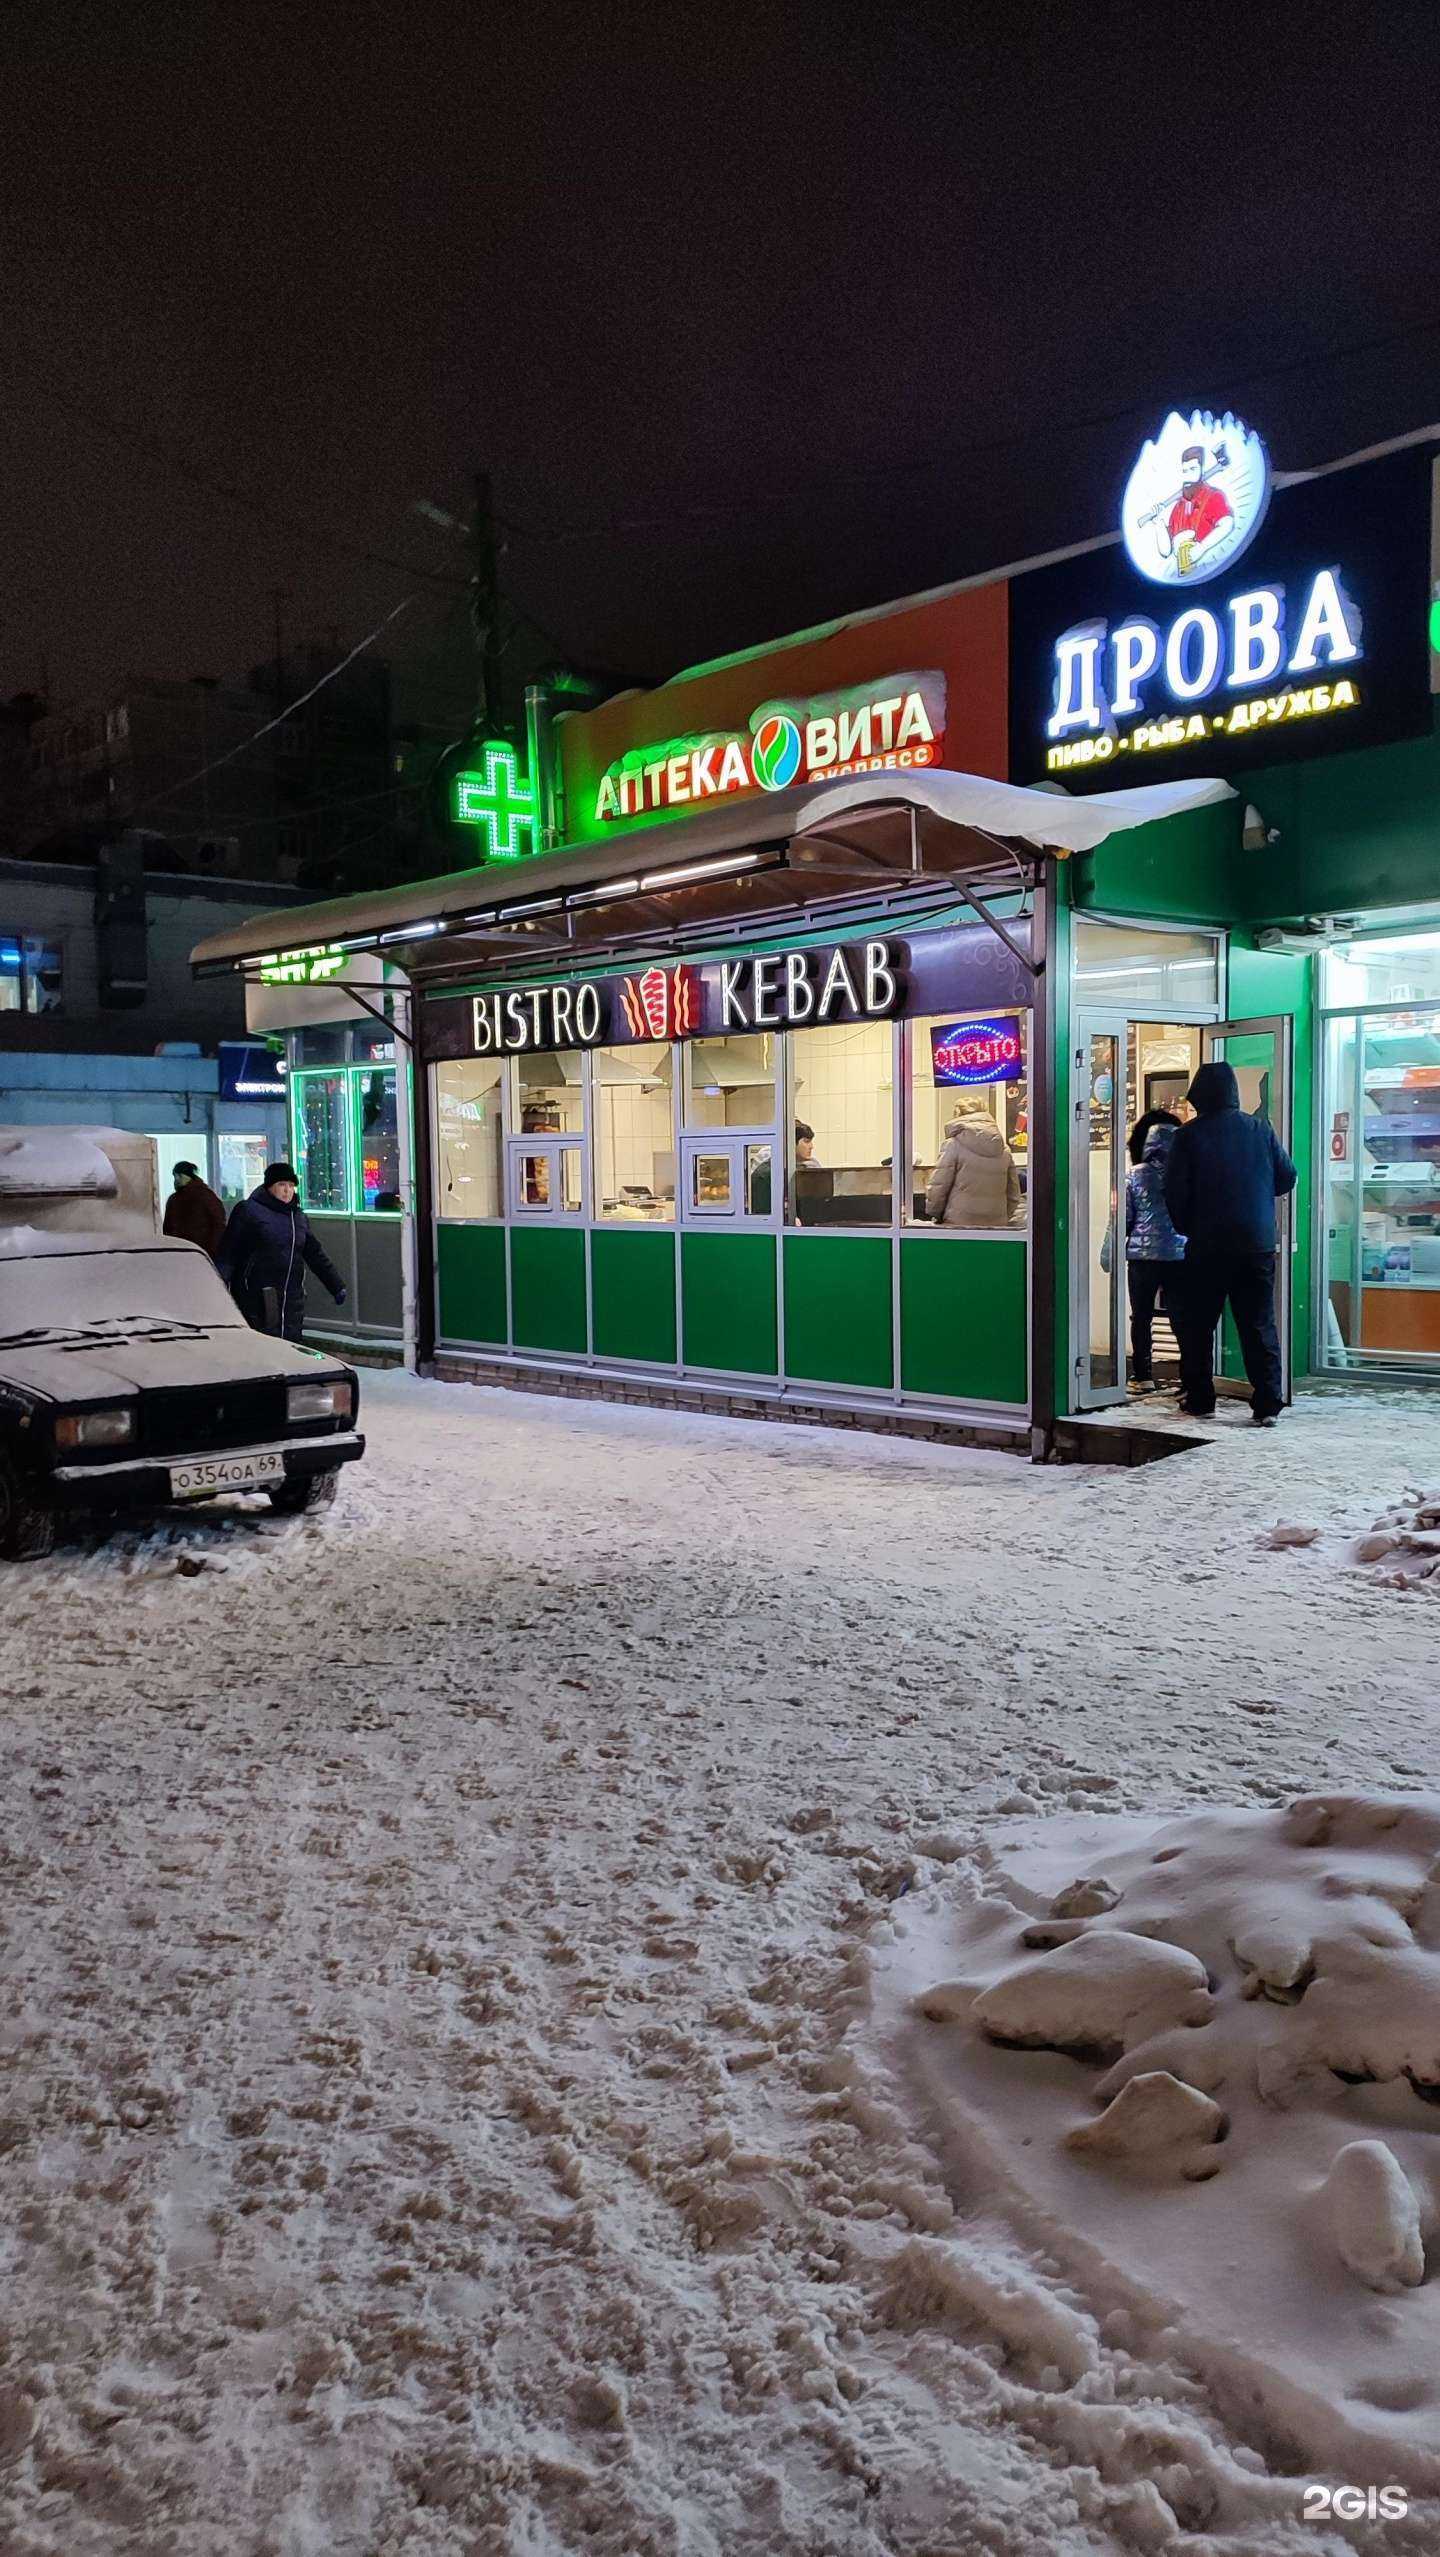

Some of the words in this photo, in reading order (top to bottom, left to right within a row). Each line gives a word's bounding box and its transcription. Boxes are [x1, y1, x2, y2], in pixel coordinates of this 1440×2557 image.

[1047, 569, 1357, 737] ДРОВА
[595, 741, 750, 820] АПТЕКА
[805, 692, 935, 770] ВИТА
[1047, 736, 1113, 769] ПИВО
[1133, 714, 1206, 750] РЫБА
[1227, 681, 1355, 732] ДРУЖБА
[473, 984, 600, 1051] BISTRO
[721, 942, 895, 1027] KEBAB
[934, 1037, 1017, 1070] ОТКРЫТО
[259, 1456, 277, 1471] 69
